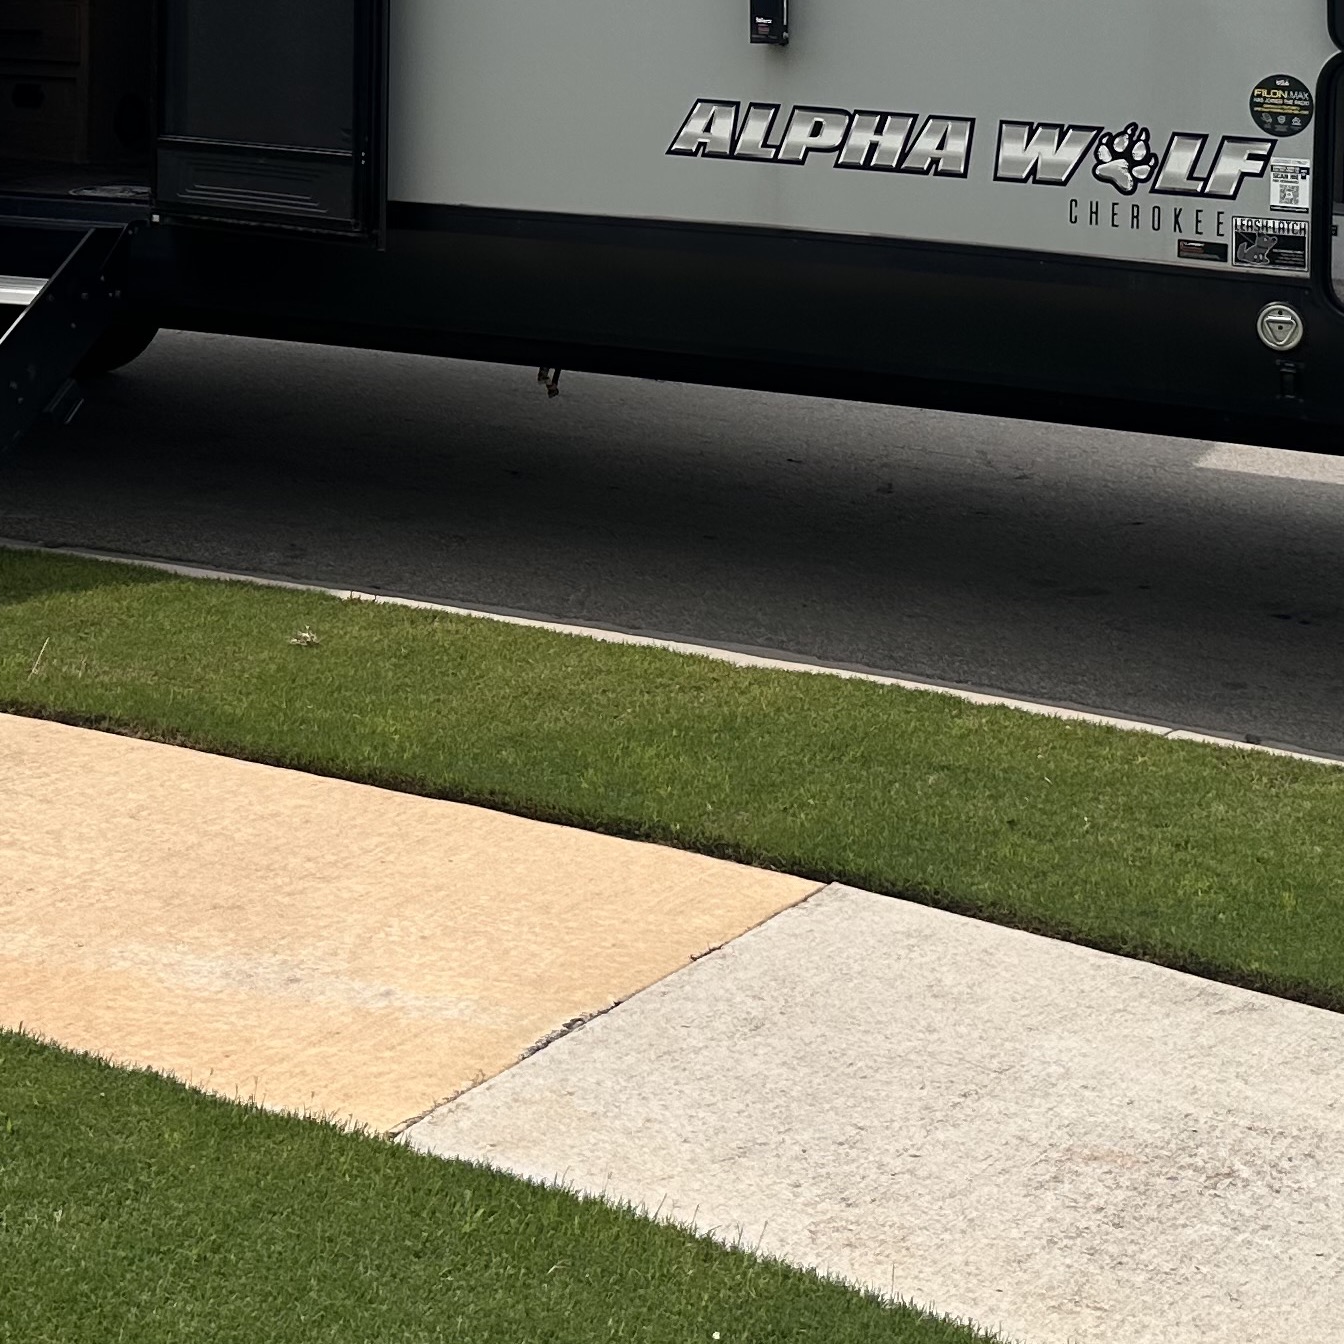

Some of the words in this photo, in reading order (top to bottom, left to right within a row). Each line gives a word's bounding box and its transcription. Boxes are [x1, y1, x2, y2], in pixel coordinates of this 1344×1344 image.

[1253, 88, 1288, 98] FILON
[665, 98, 976, 179] ALPHA
[1069, 198, 1225, 237] CHEROKEE
